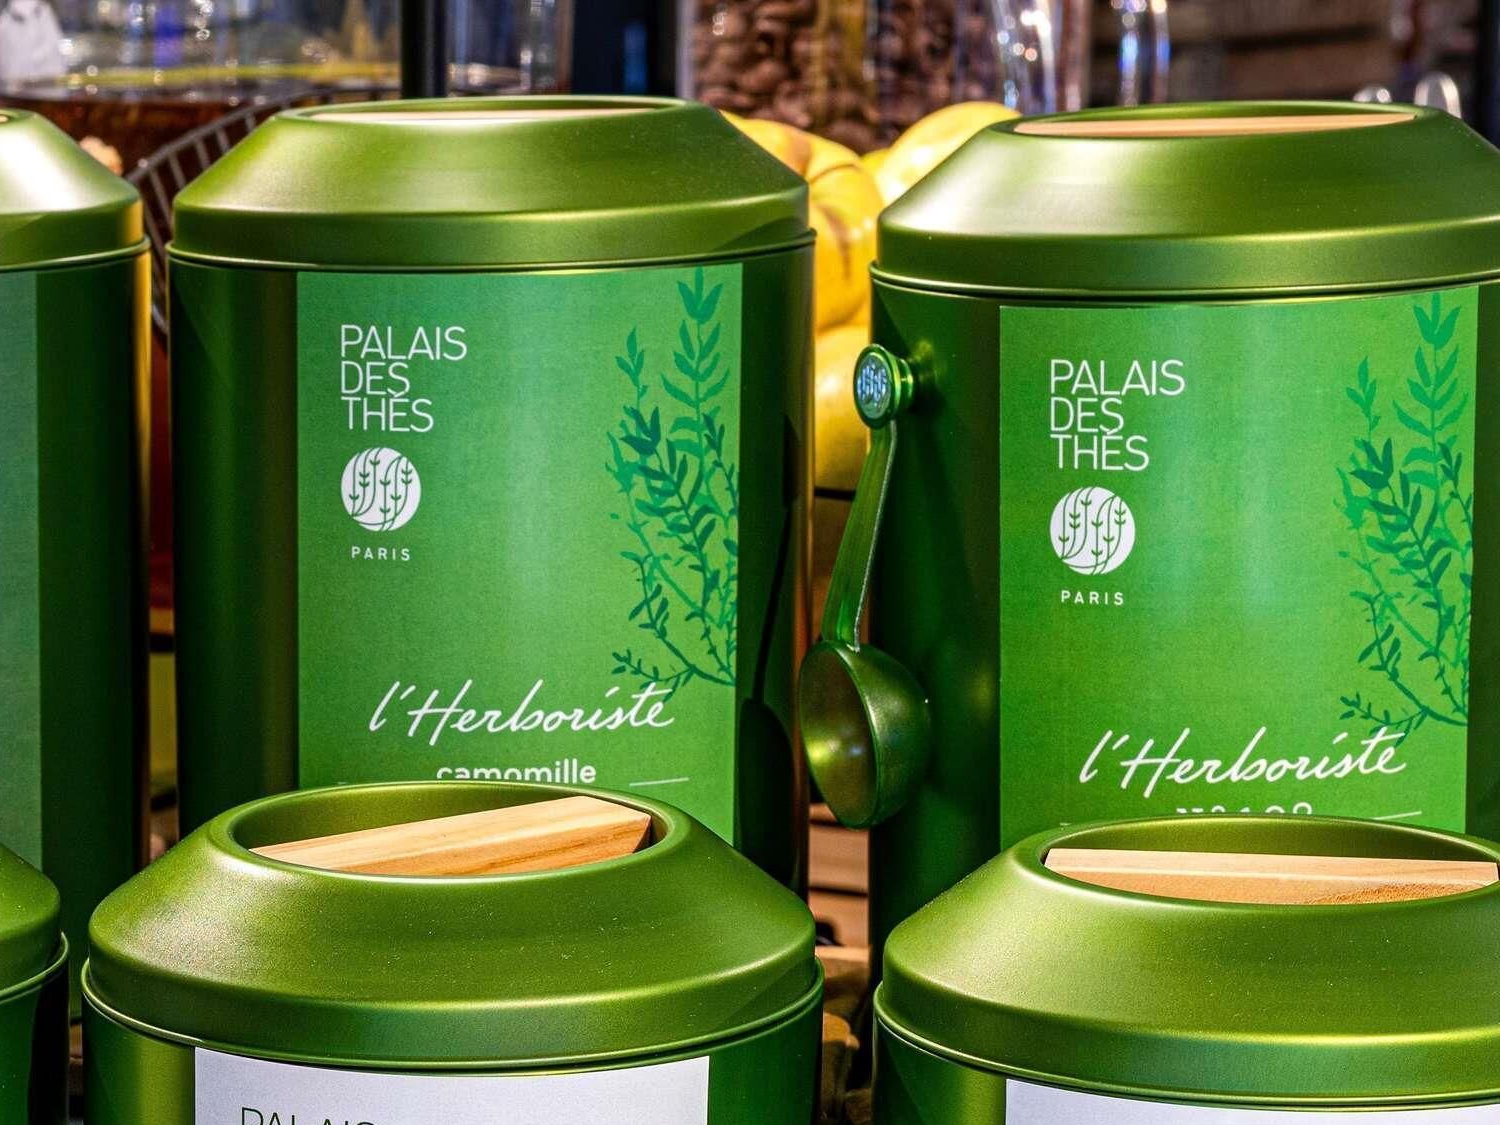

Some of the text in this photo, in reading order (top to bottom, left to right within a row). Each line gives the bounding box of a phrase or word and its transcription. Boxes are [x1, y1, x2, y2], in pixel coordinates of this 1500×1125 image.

[341, 325, 467, 361] PALAIS
[341, 362, 410, 397] DES
[1050, 359, 1185, 396] PALAIS
[341, 393, 434, 433] THÉS
[1050, 398, 1124, 433] DES
[1050, 430, 1149, 472] THÉS
[352, 546, 410, 561] PARIS
[1061, 590, 1123, 605] PARIS
